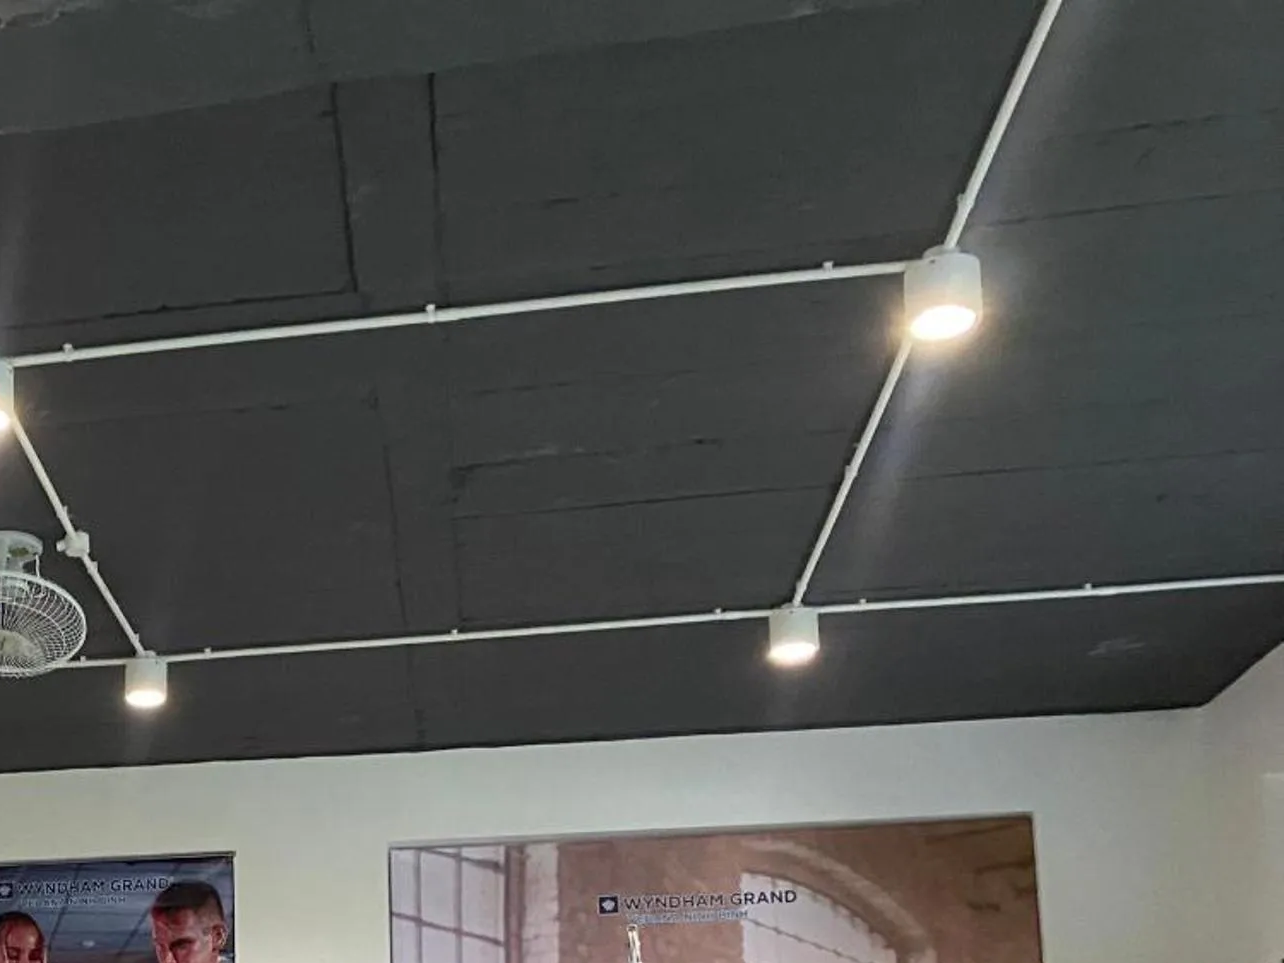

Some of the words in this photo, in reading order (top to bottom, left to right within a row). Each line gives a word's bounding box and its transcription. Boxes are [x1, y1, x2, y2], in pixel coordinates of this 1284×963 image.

[19, 879, 105, 895] WYNDHAM
[110, 877, 169, 892] GRAND
[624, 894, 723, 910] WYNDHAM
[730, 889, 797, 906] GRAND
